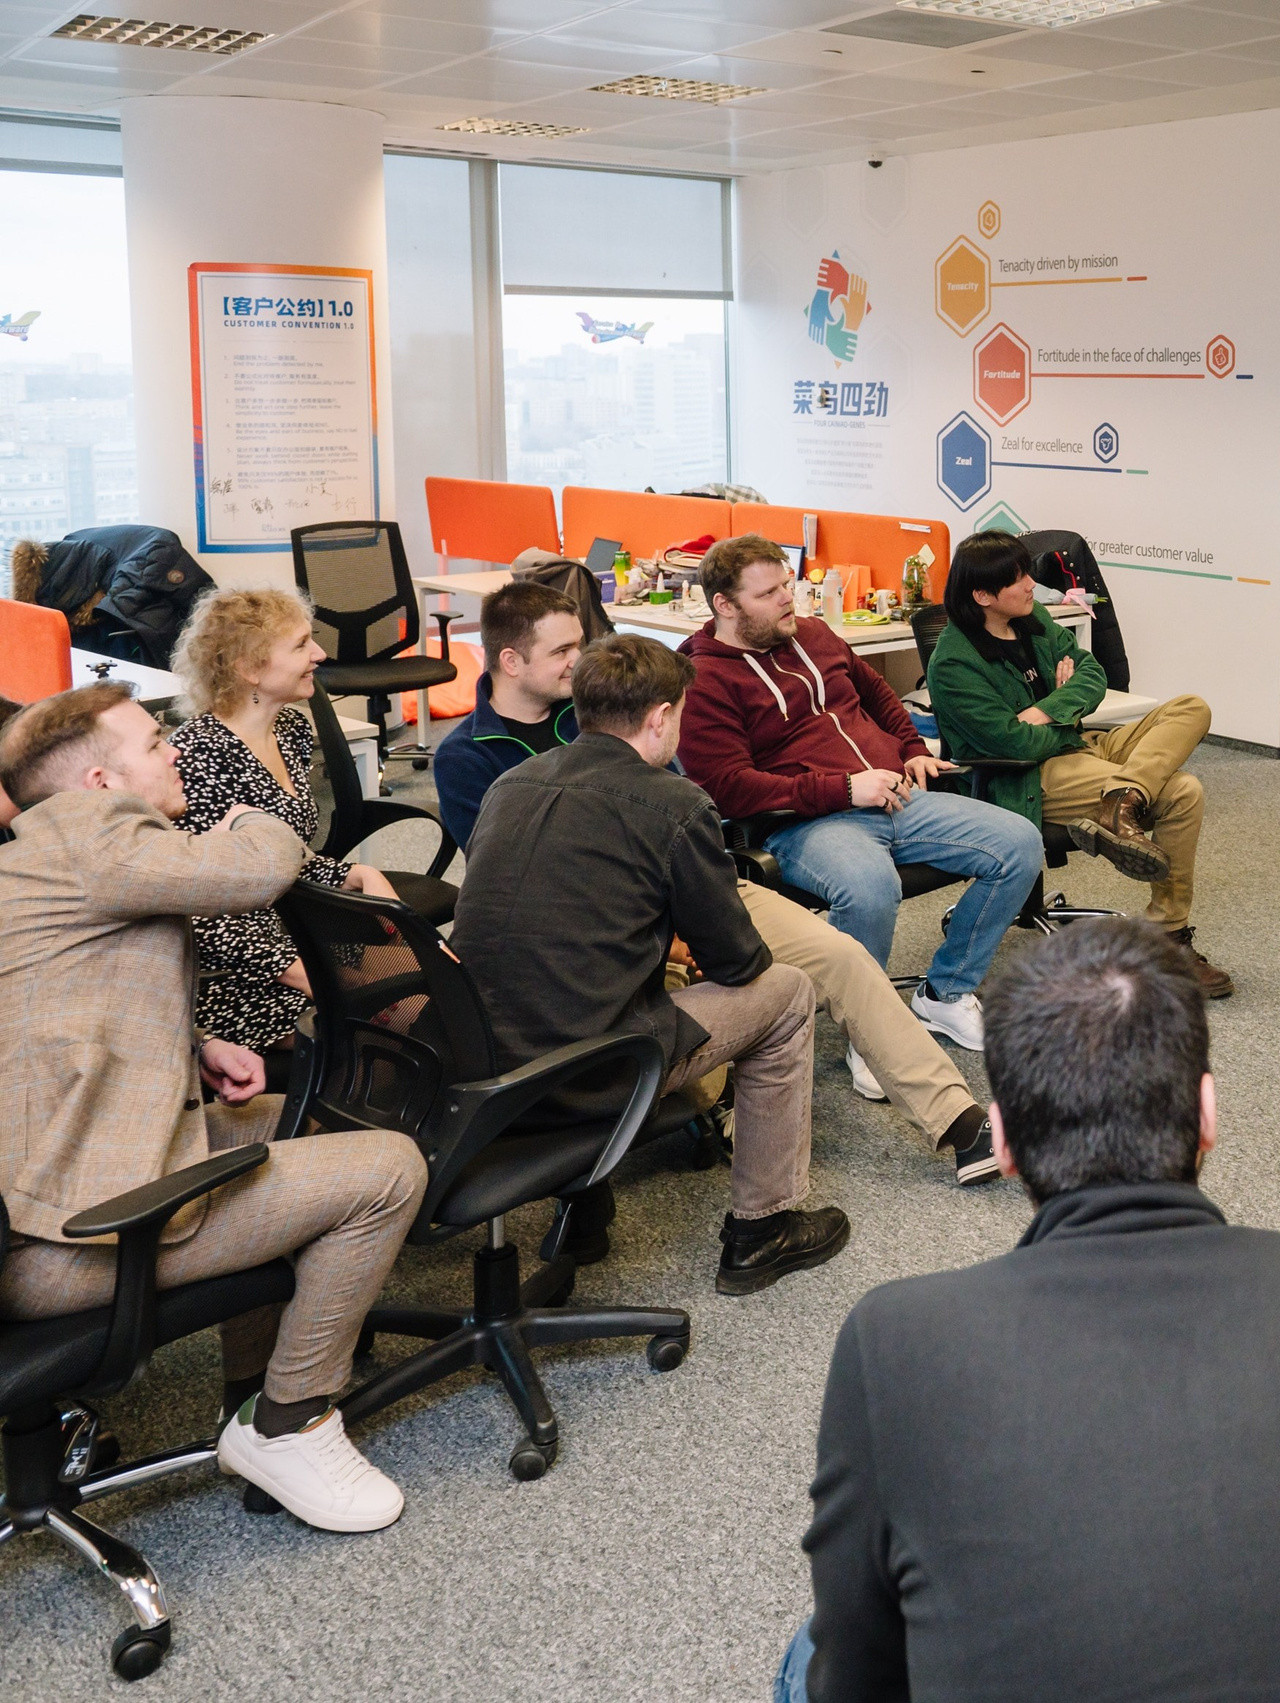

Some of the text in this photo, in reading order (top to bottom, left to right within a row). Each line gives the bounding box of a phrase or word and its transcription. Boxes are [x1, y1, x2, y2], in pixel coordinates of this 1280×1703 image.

[999, 254, 1118, 274] Tenacity driven by mission
[946, 282, 979, 292] Tenacity
[328, 300, 353, 317] 1.0
[224, 320, 277, 328] CUSTOMER
[281, 320, 341, 329] CONVENTION
[1037, 347, 1201, 366] Fortitude in the face of challenges
[983, 370, 1021, 379] Fortitude
[813, 419, 827, 428] FOUR
[1001, 436, 1083, 454] Zeal for excellence
[955, 456, 973, 466] Zeal
[1099, 540, 1134, 556] greater
[1136, 544, 1183, 560] customer
[1185, 548, 1214, 564] value
